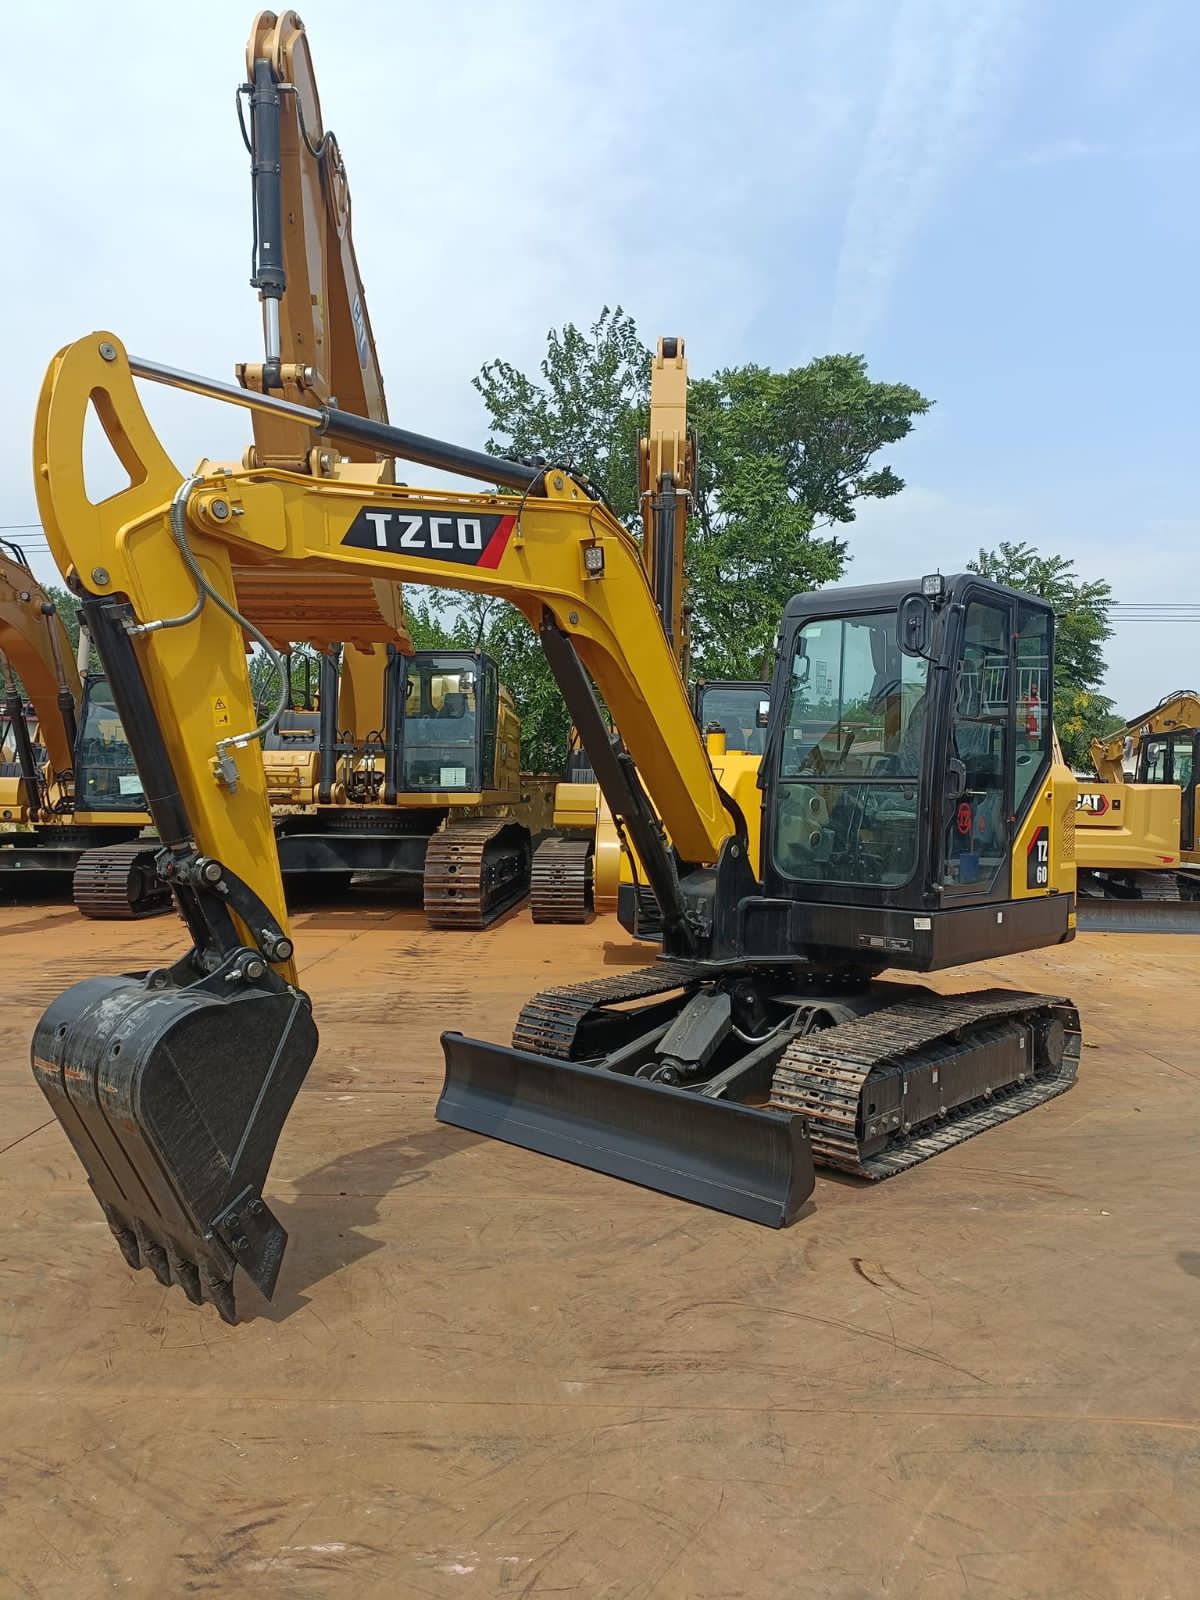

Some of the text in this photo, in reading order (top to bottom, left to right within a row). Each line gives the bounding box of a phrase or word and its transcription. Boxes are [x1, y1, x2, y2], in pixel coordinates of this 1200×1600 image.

[365, 512, 483, 550] TZCO
[1036, 840, 1048, 862] TZ
[1036, 866, 1048, 884] 60
